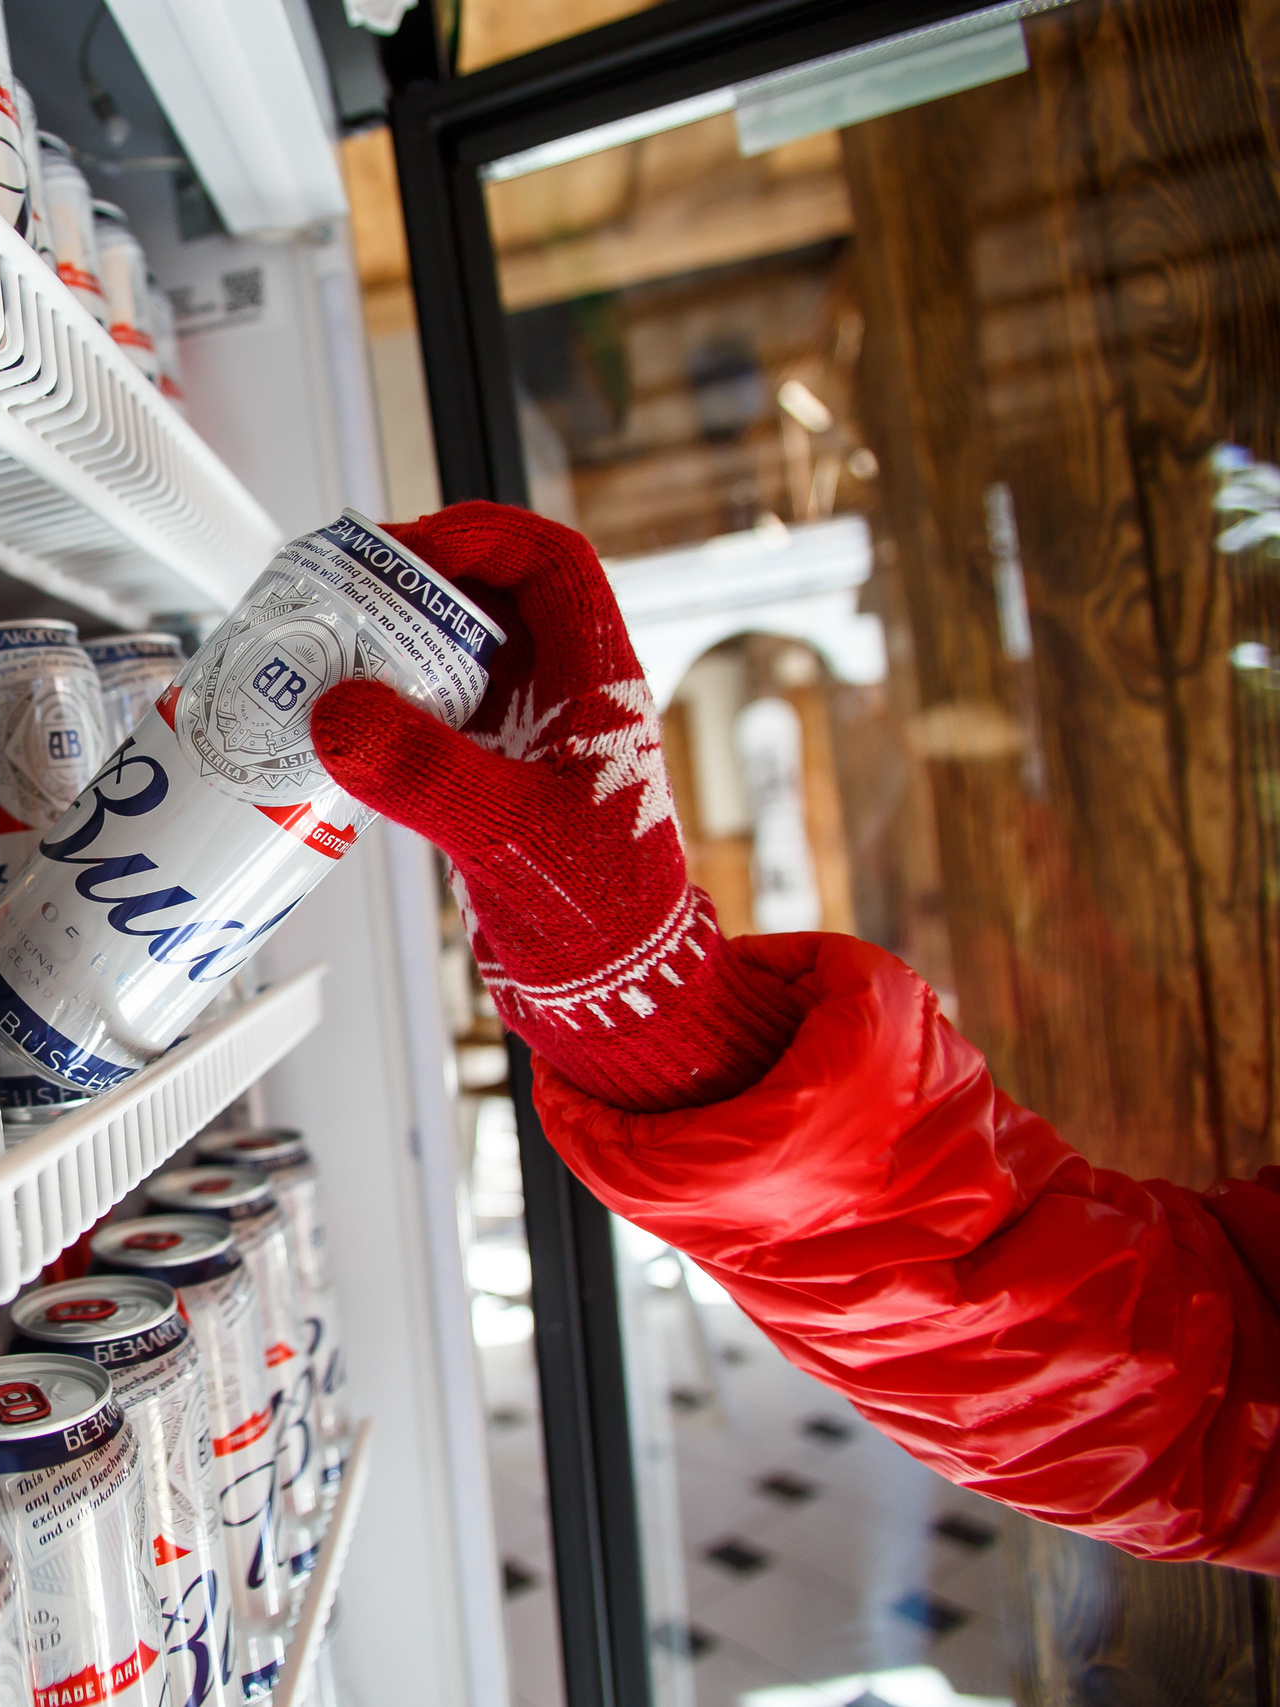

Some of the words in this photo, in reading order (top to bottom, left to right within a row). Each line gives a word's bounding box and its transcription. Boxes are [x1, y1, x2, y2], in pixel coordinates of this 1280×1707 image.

[300, 558, 321, 573] you
[320, 568, 344, 586] will
[324, 518, 487, 653] ЗАЛКОГОЛЬНЫЙ
[336, 581, 369, 605] find
[249, 603, 293, 629] AUSTRALIA
[327, 554, 362, 579] Aging
[358, 576, 414, 623] produces
[412, 623, 422, 633] a
[420, 630, 445, 666] taste,
[445, 664, 455, 674] a
[364, 600, 380, 617] in
[378, 614, 396, 632] no
[395, 631, 424, 662] other
[420, 660, 442, 687] beer
[457, 653, 473, 676] and
[204, 666, 221, 704] AFRICA
[437, 686, 450, 700] at
[443, 698, 456, 717] any
[48, 729, 82, 760] AB
[195, 735, 243, 780] AMERICA
[278, 751, 316, 770] ASIA
[39, 736, 306, 984] Bud
[16, 1471, 44, 1497] This
[46, 1466, 57, 1479] is
[25, 1491, 51, 1514] any
[53, 1465, 83, 1496] other
[32, 1486, 90, 1529] exclusive
[90, 1435, 131, 1491] Beechwood
[38, 1524, 64, 1546] and
[66, 1517, 75, 1529] a
[36, 1682, 96, 1707] TRADE
